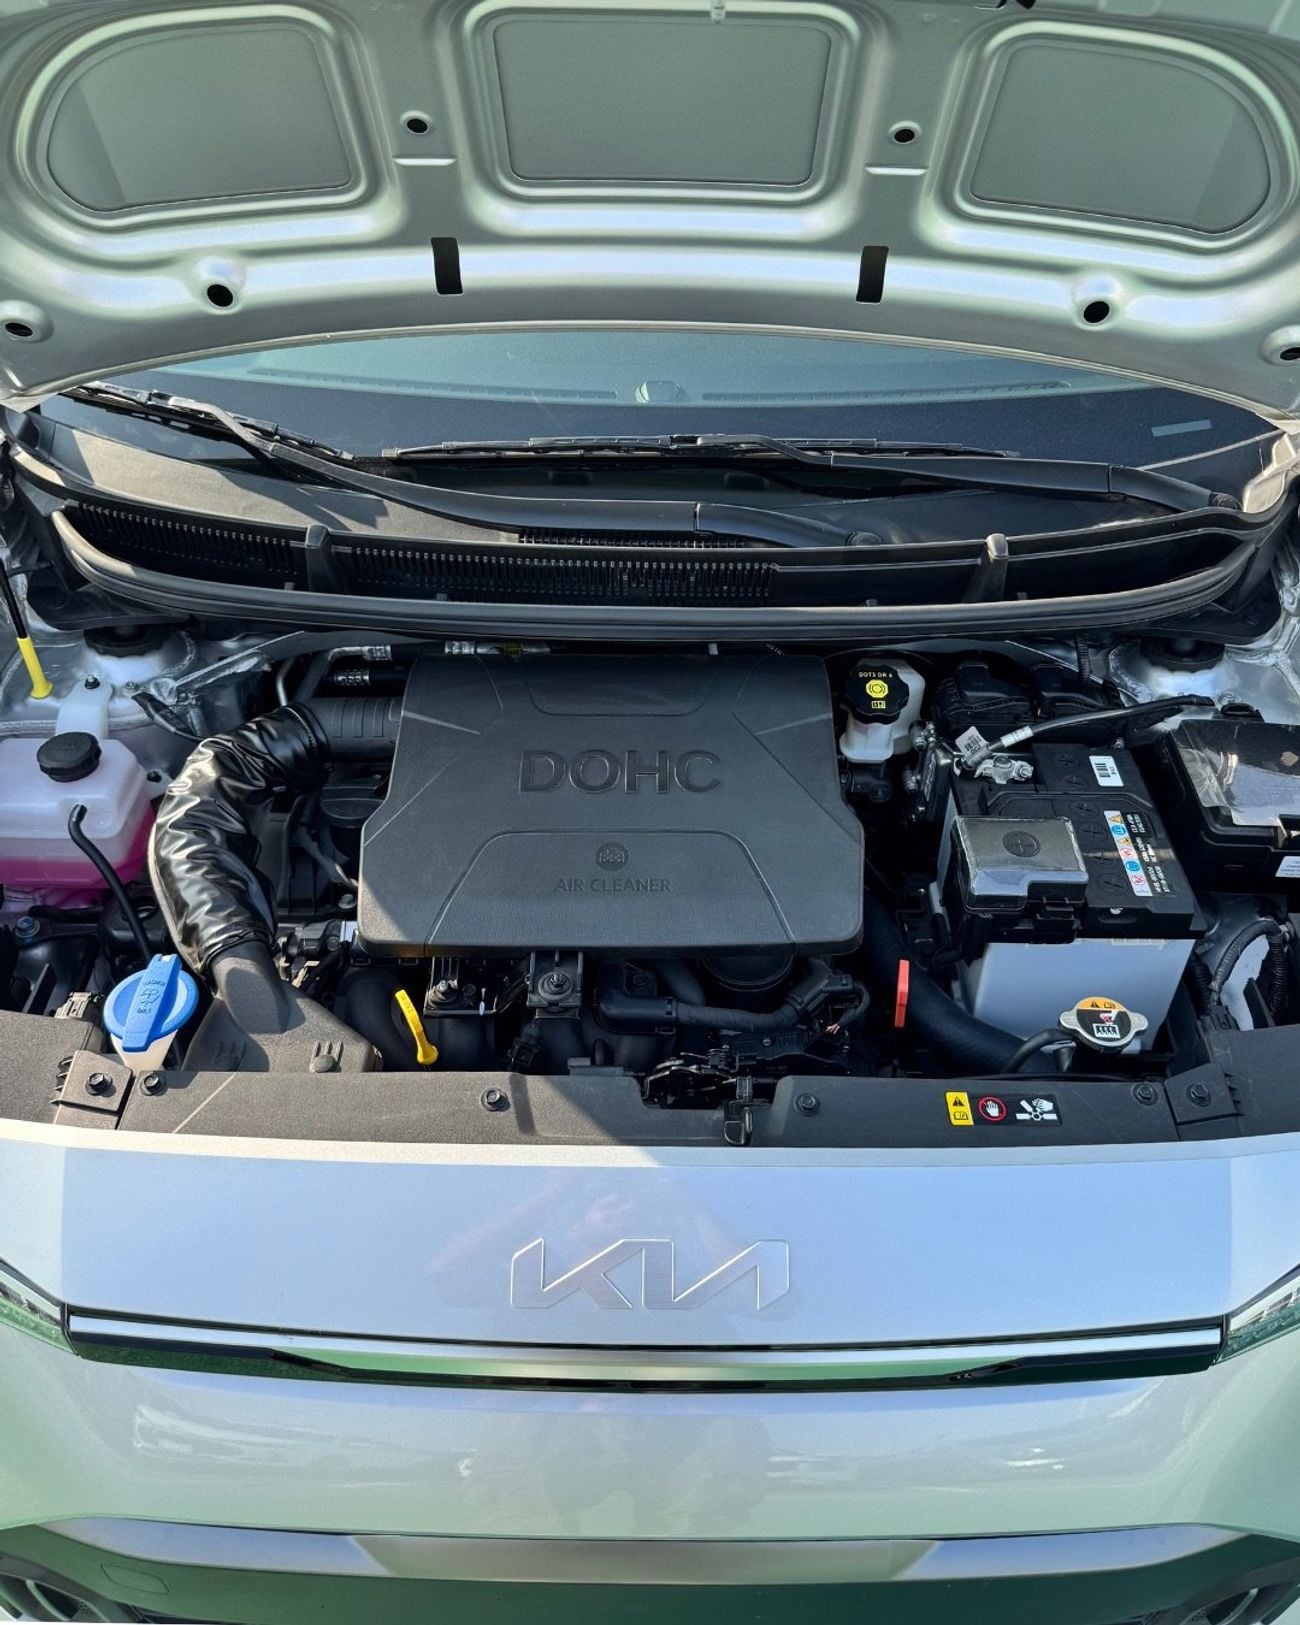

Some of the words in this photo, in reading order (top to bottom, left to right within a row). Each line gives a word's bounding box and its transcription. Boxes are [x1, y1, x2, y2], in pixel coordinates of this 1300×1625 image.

[519, 749, 722, 794] DOHC
[555, 878, 585, 893] AIR
[590, 878, 671, 893] CLEANER
